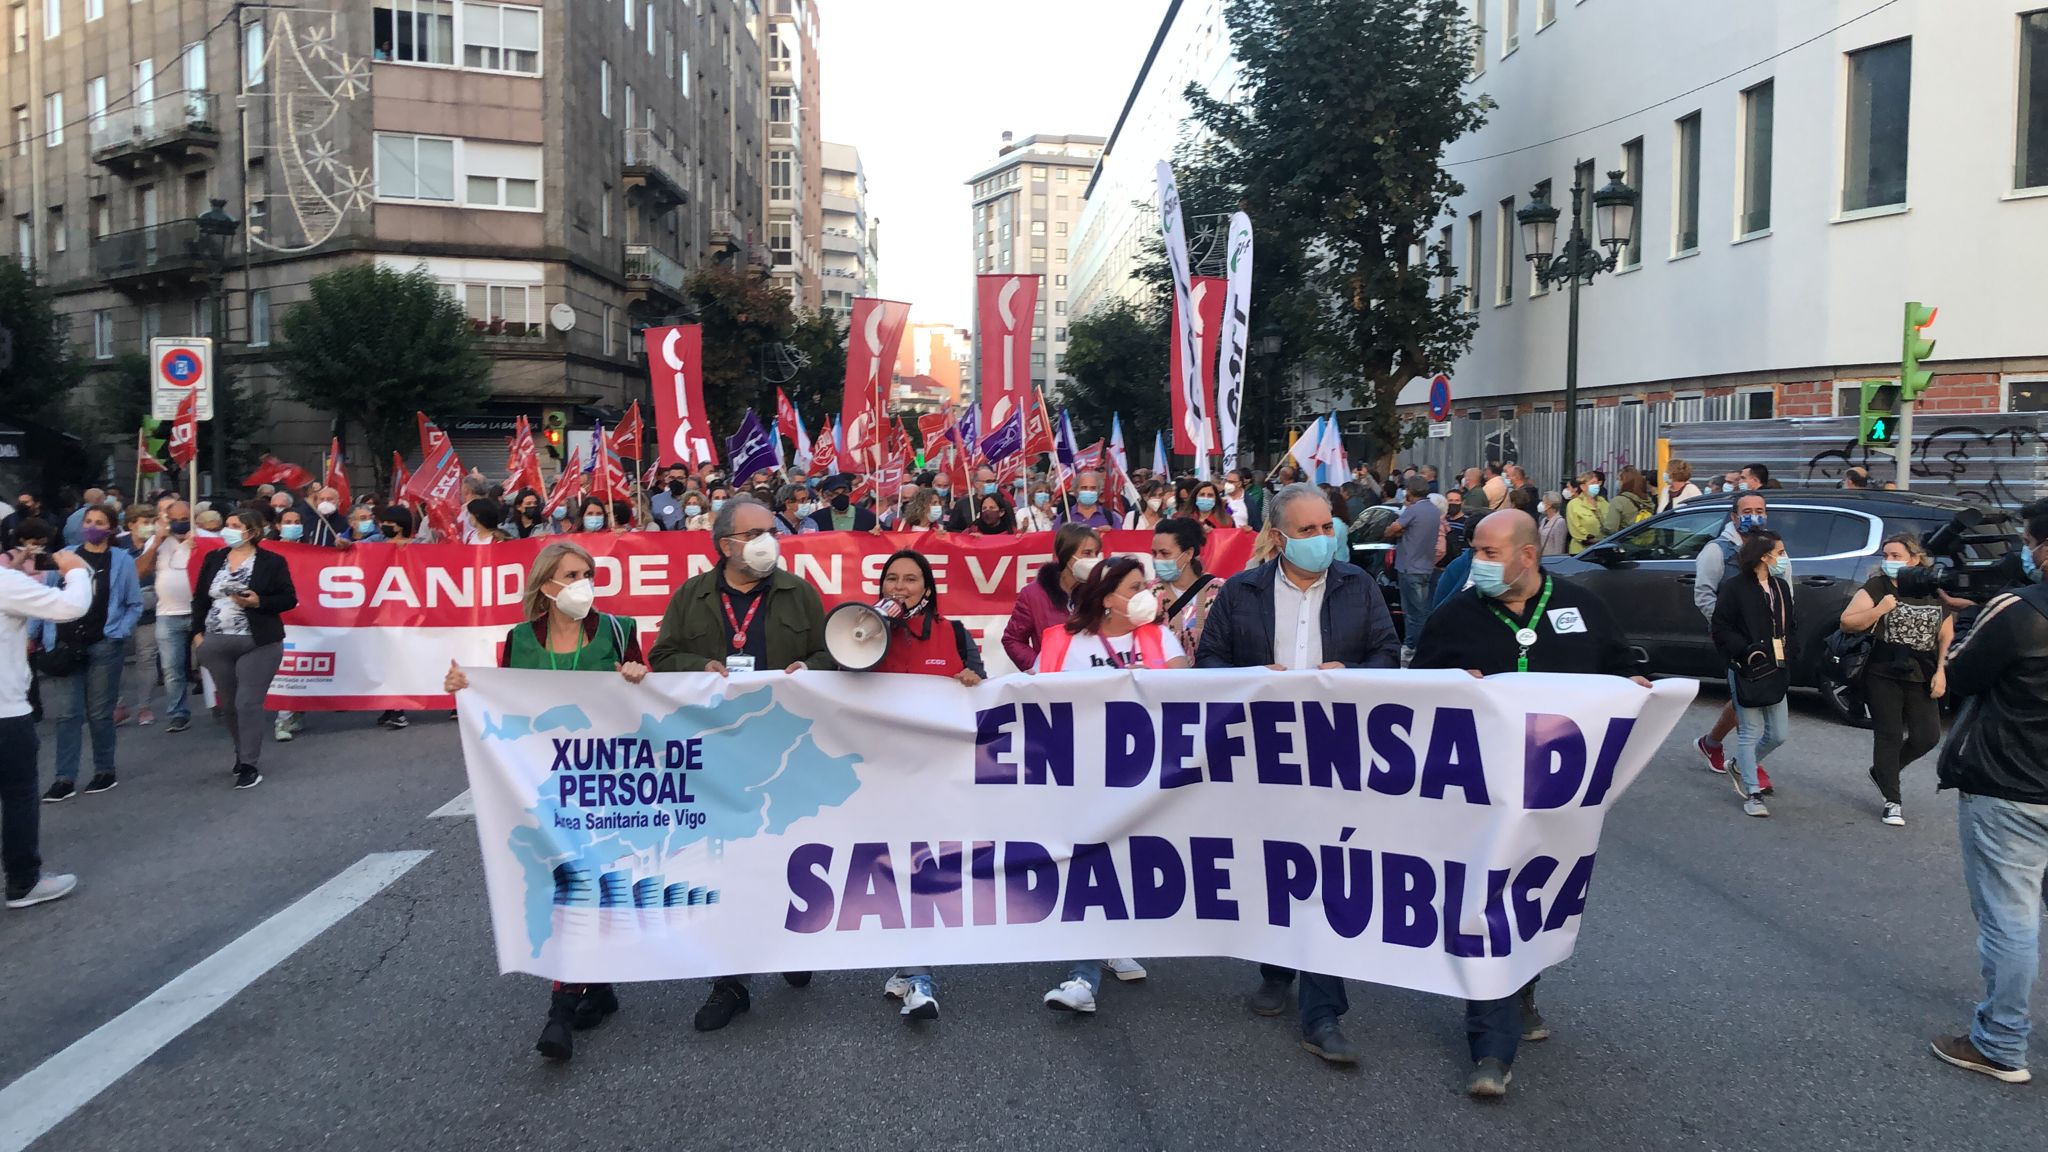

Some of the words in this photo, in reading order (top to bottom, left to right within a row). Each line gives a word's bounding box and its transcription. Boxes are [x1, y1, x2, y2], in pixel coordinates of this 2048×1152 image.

[318, 553, 670, 609] SANIDDE
[965, 552, 1155, 595] VED
[279, 656, 331, 671] COO
[551, 738, 655, 770] XUNTA
[666, 738, 703, 769] DE
[975, 702, 1074, 786] EN
[1105, 701, 1491, 805] DEFENSA
[560, 772, 695, 807] PERSOAL
[586, 811, 649, 830] Sanitaria
[653, 810, 670, 827] de
[675, 809, 706, 829] Vigo
[784, 835, 1240, 934] SANIDADE
[1263, 826, 1597, 958] PÚBLICA
